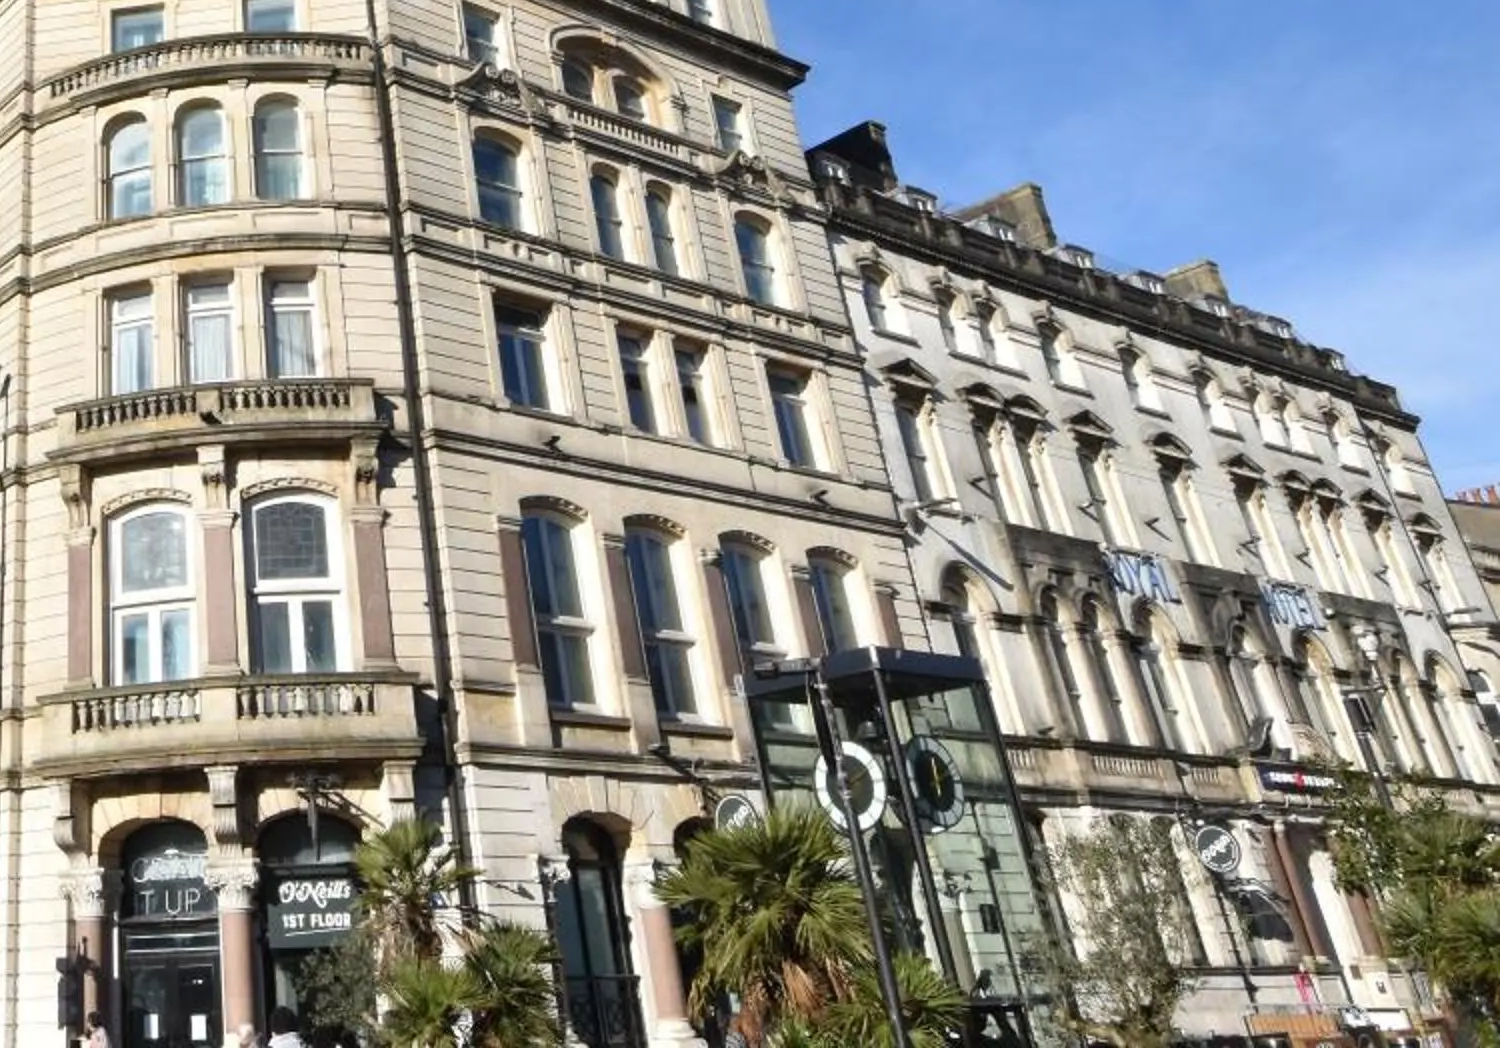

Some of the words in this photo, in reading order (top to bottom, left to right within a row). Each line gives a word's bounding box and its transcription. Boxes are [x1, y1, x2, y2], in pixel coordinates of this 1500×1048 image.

[165, 887, 201, 915] UP
[278, 879, 351, 908] O'Neill's
[282, 913, 305, 929] 1ST
[309, 912, 351, 928] FLOOR
